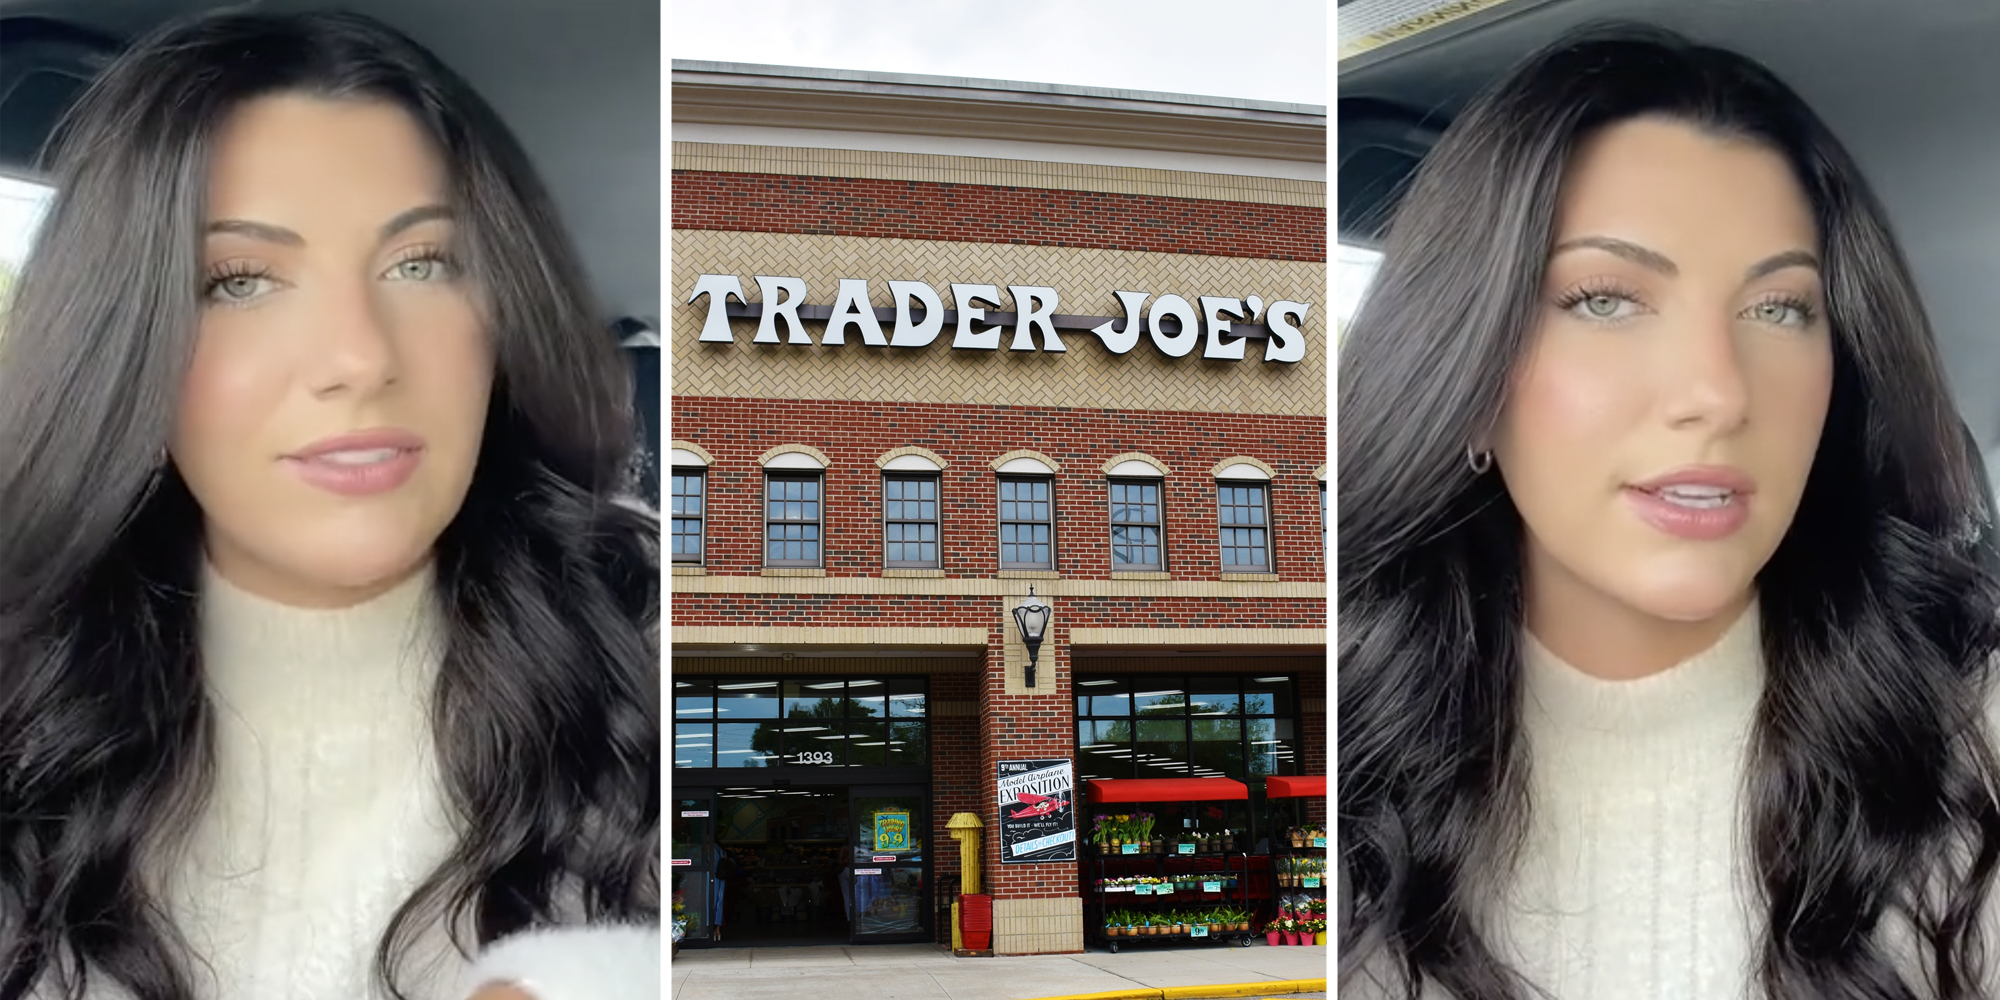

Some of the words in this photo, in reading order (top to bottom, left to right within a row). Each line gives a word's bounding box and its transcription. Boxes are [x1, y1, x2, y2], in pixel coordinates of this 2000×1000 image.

[688, 274, 1067, 354] TRADER
[1091, 290, 1310, 365] JOE'S
[796, 751, 833, 765] 1393
[1009, 764, 1028, 772] ANNUAL
[999, 777, 1026, 789] Model
[1027, 769, 1064, 782] Airplane
[1000, 775, 1070, 804] EXPOSITION
[1015, 840, 1038, 854] DETAILS
[1042, 830, 1074, 847] CHECKOUT!
